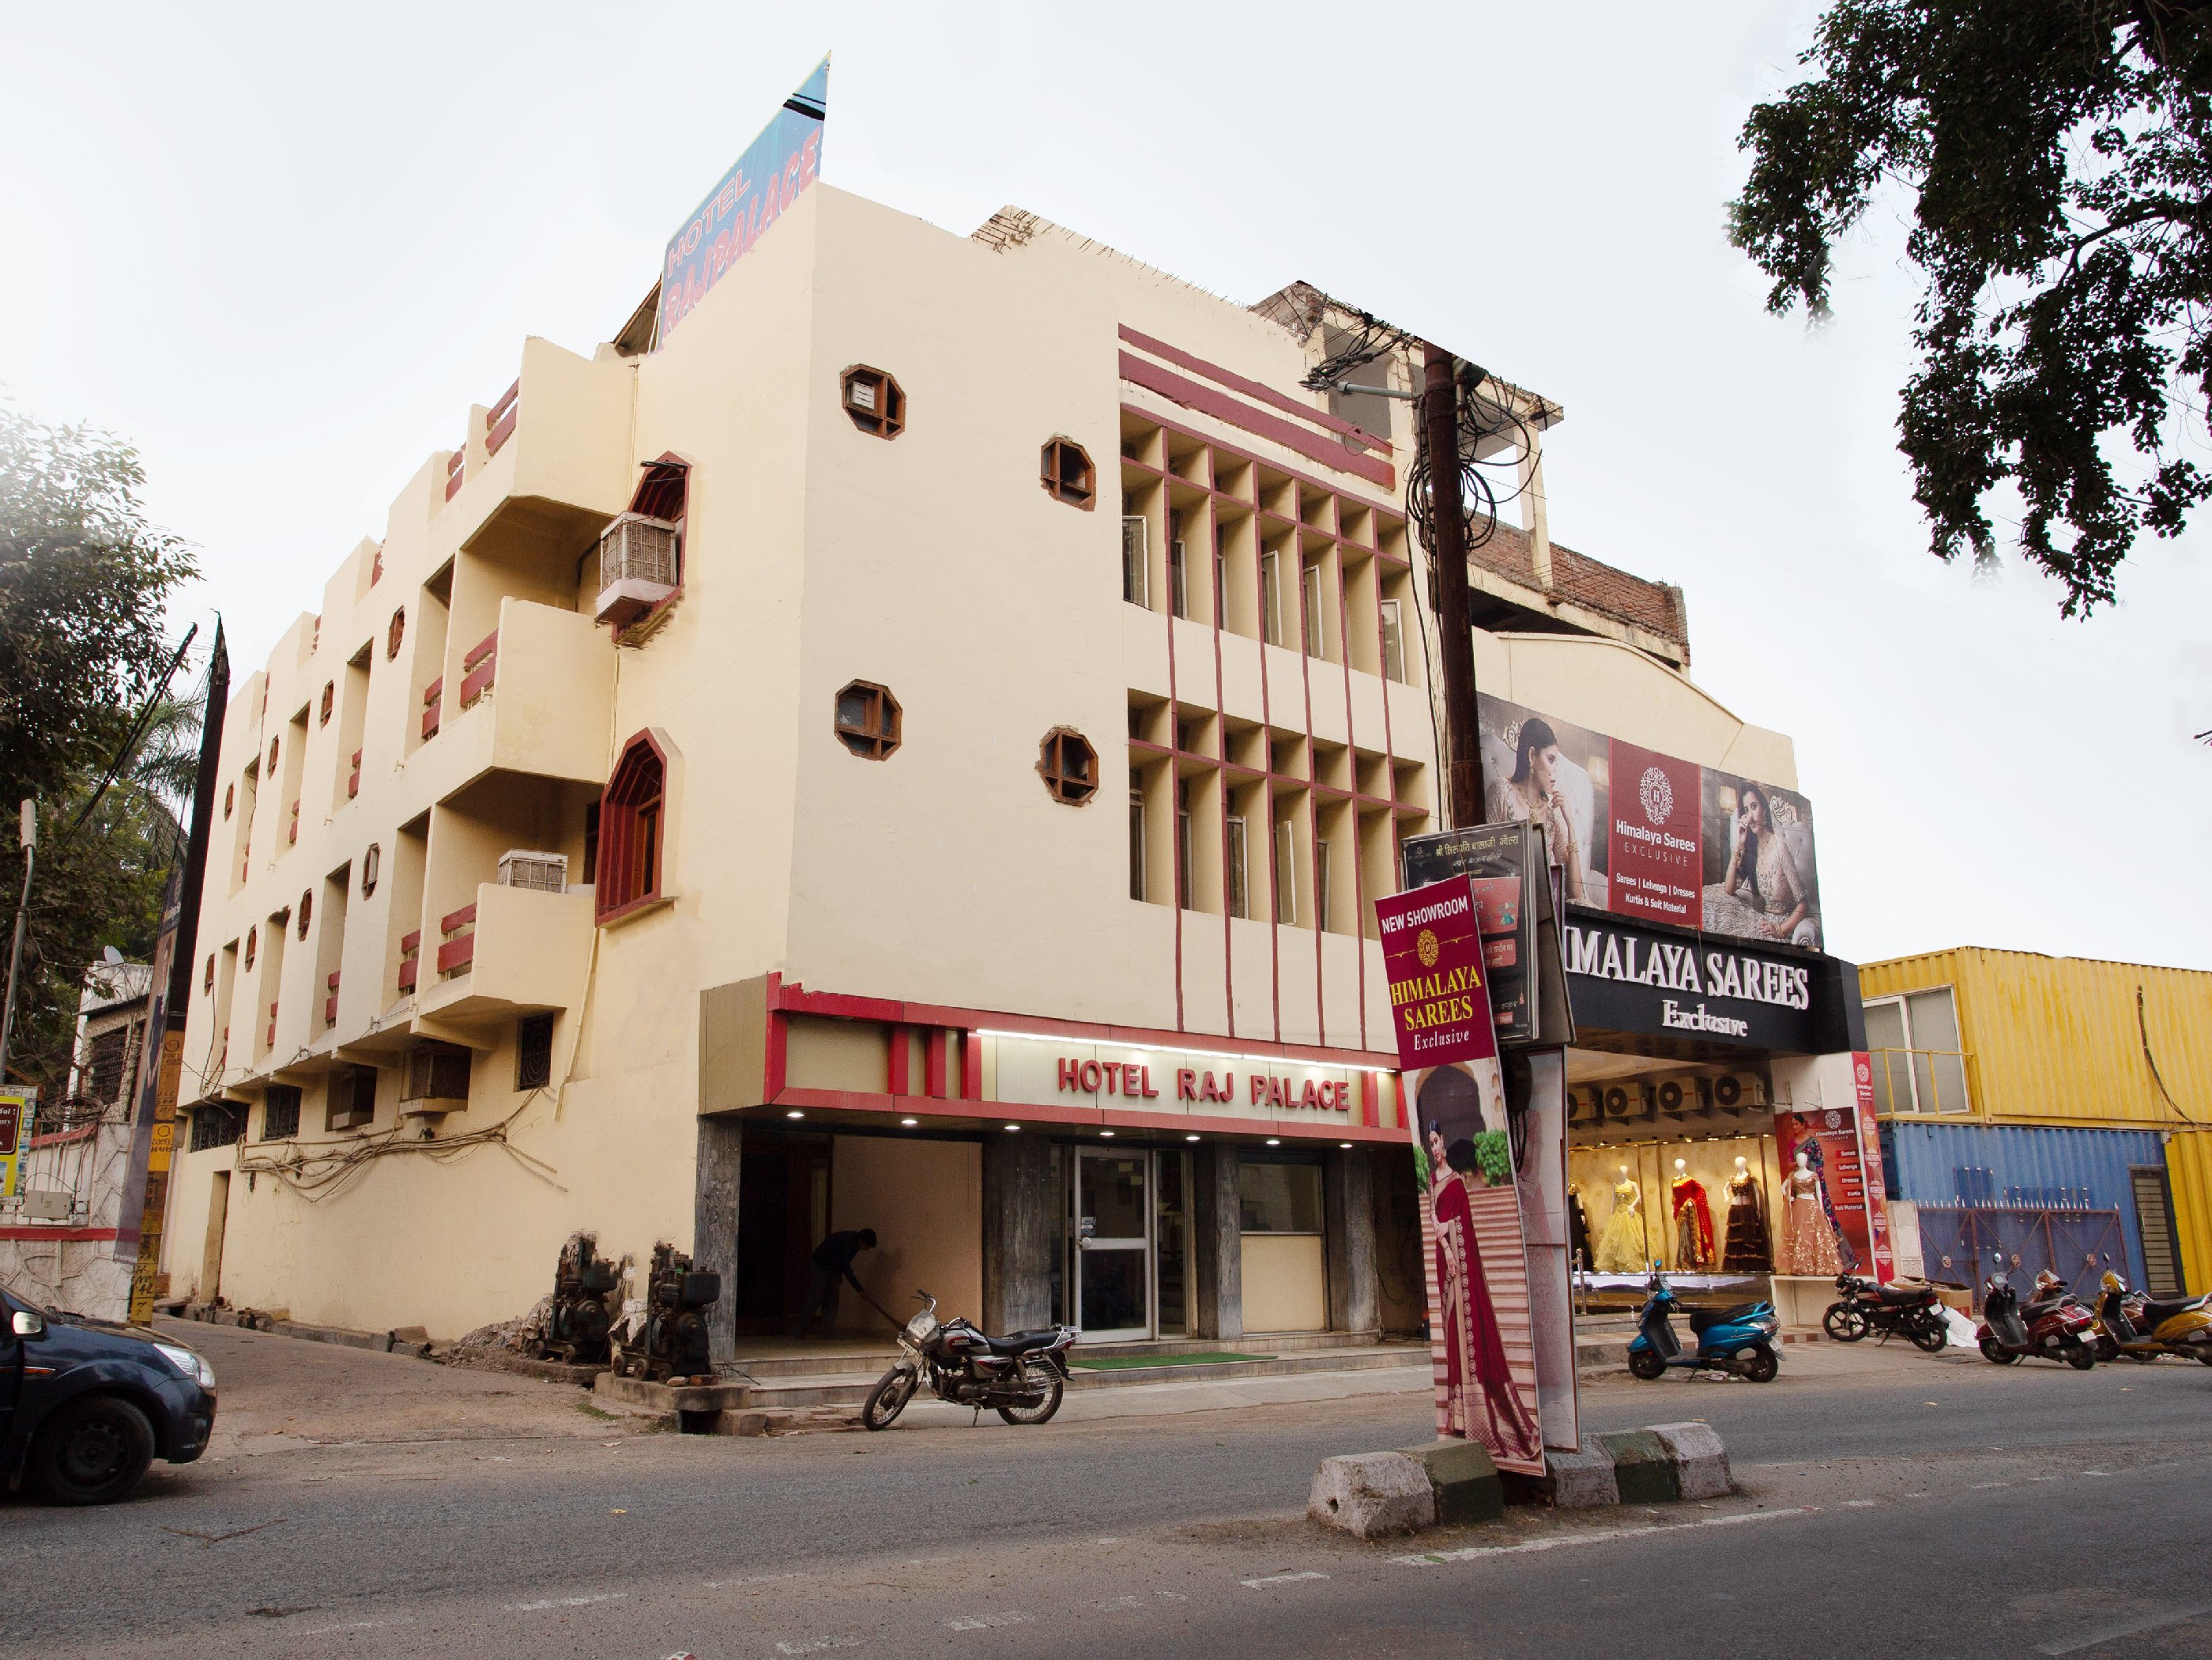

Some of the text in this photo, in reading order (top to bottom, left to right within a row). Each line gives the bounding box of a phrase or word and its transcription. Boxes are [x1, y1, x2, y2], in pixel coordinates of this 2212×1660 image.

[663, 126, 820, 338] RAJ PALACE
[667, 169, 751, 278] HOTEL
[1616, 819, 1696, 852] Himalaya Sarees
[1624, 842, 1687, 866] EXCLUSIVE
[1616, 873, 1637, 886] Sarees
[1642, 878, 1667, 894] Lehenga
[1672, 885, 1696, 899] Dresses
[1625, 893, 1686, 914] Kurtis & Suit Material
[1381, 896, 1468, 934] NEW SHOWROOM
[1390, 965, 1482, 1005] HIMALAYA
[1707, 953, 1808, 1010] SAREES
[1404, 995, 1473, 1031] SAREES
[1662, 999, 1747, 1037] Exclusive
[1414, 1029, 1469, 1051] Exclusive
[1058, 1057, 1351, 1111] HOTEL RAJ PALACE
